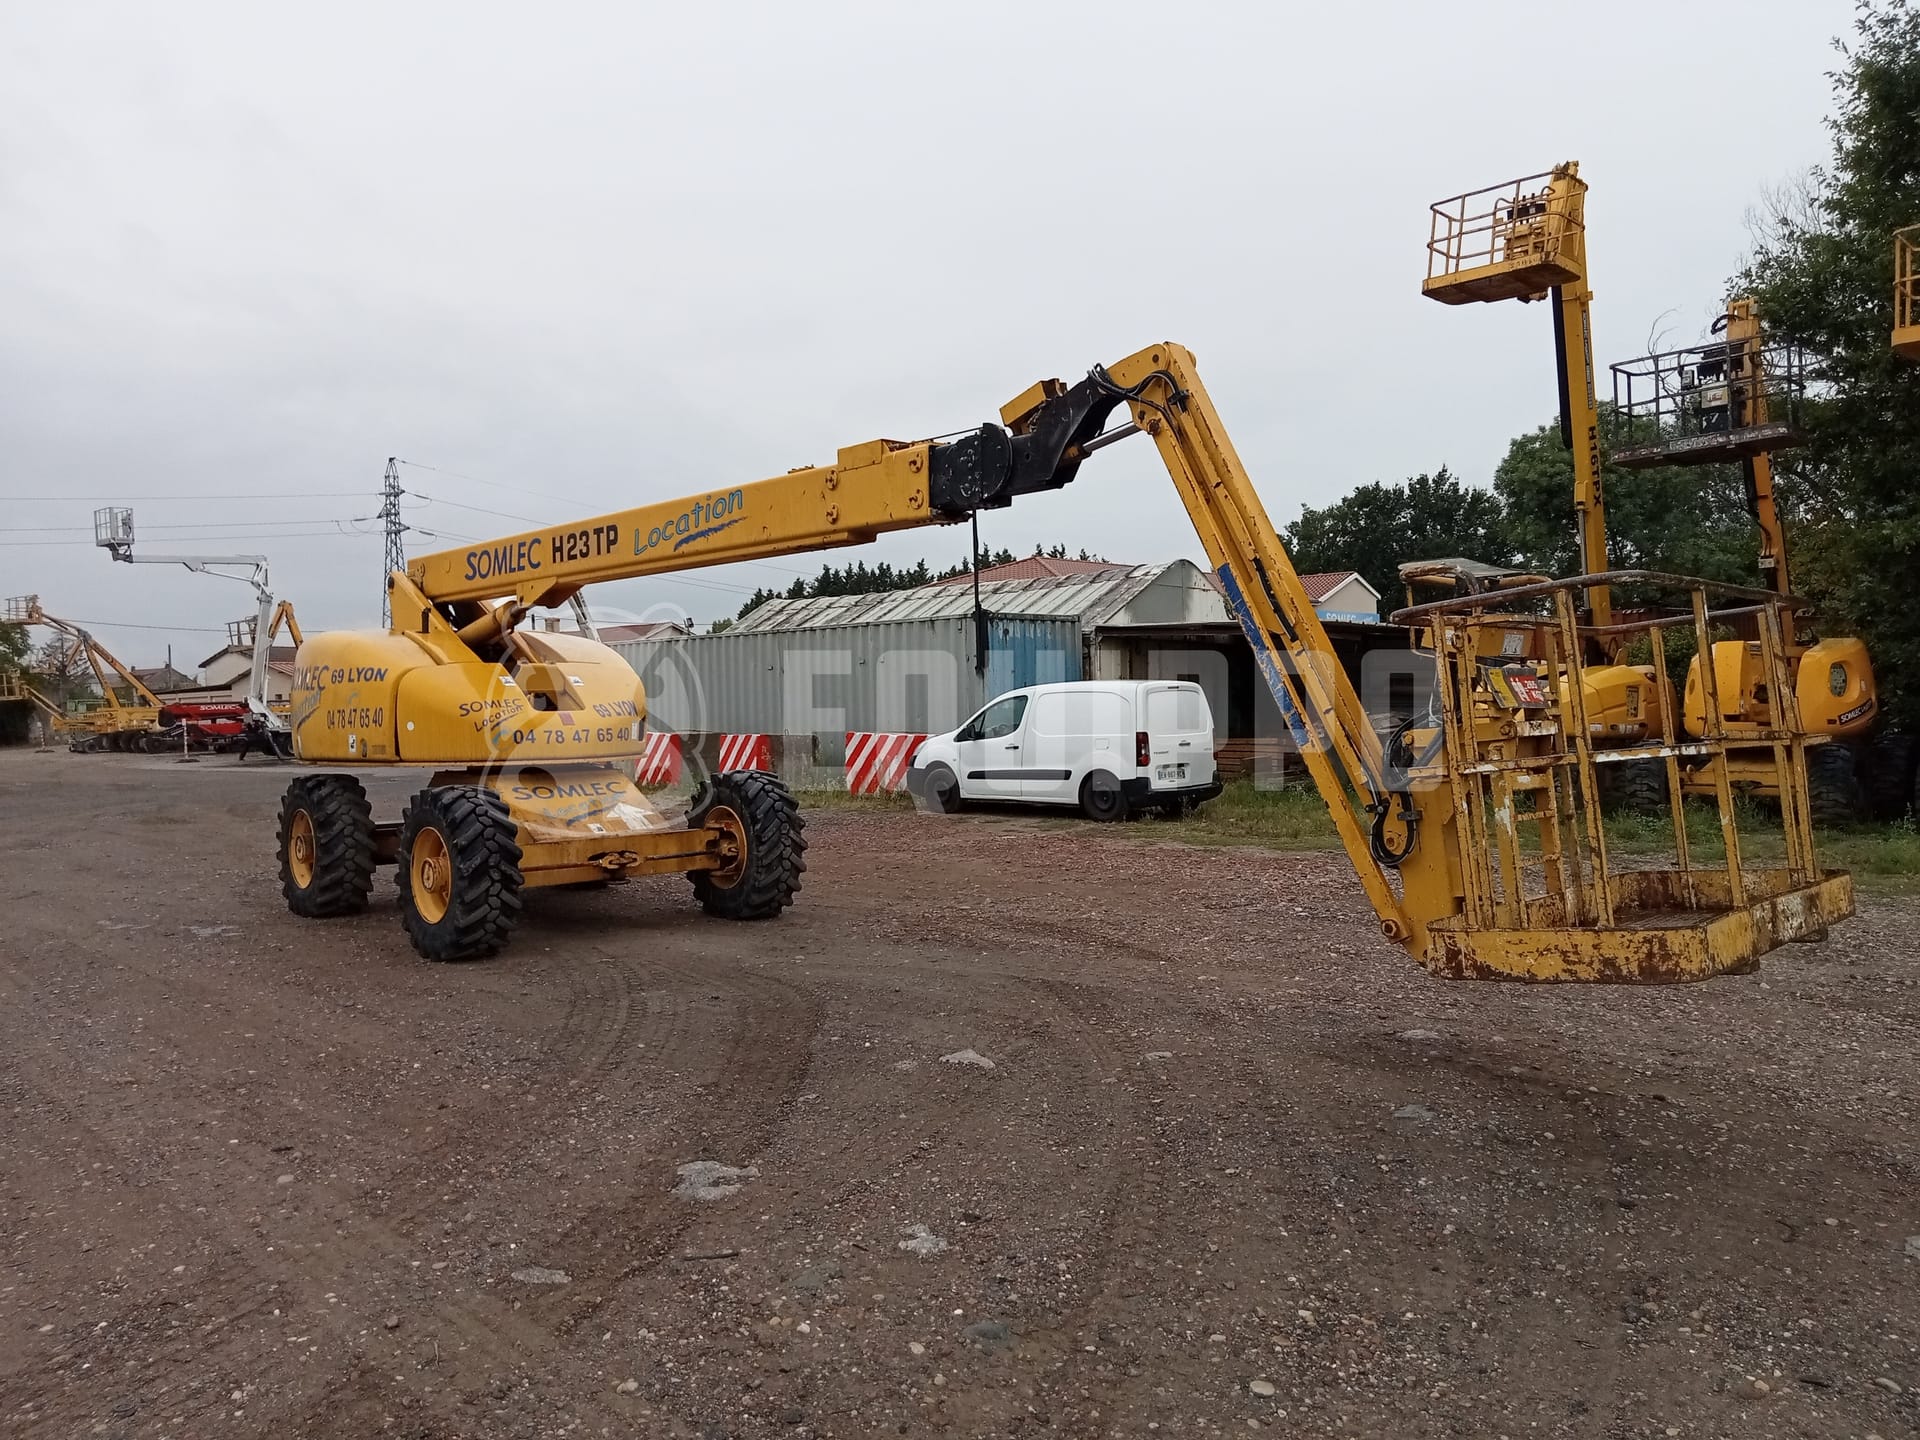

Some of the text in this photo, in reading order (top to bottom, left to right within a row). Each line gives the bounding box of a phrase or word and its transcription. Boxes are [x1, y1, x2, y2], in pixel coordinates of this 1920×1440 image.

[1588, 426, 1602, 507] H16TPX
[464, 489, 743, 581] SOMLEC H23TP Location
[331, 668, 345, 684] 69
[347, 667, 388, 683] LYON
[327, 707, 384, 729] 04 78 47 65 40
[459, 698, 522, 718] SOMLEC
[593, 700, 639, 718] 69 LYON
[473, 704, 524, 733] Location
[513, 727, 630, 745] 04 78 47 65 40
[512, 781, 627, 800] SOMLEC
